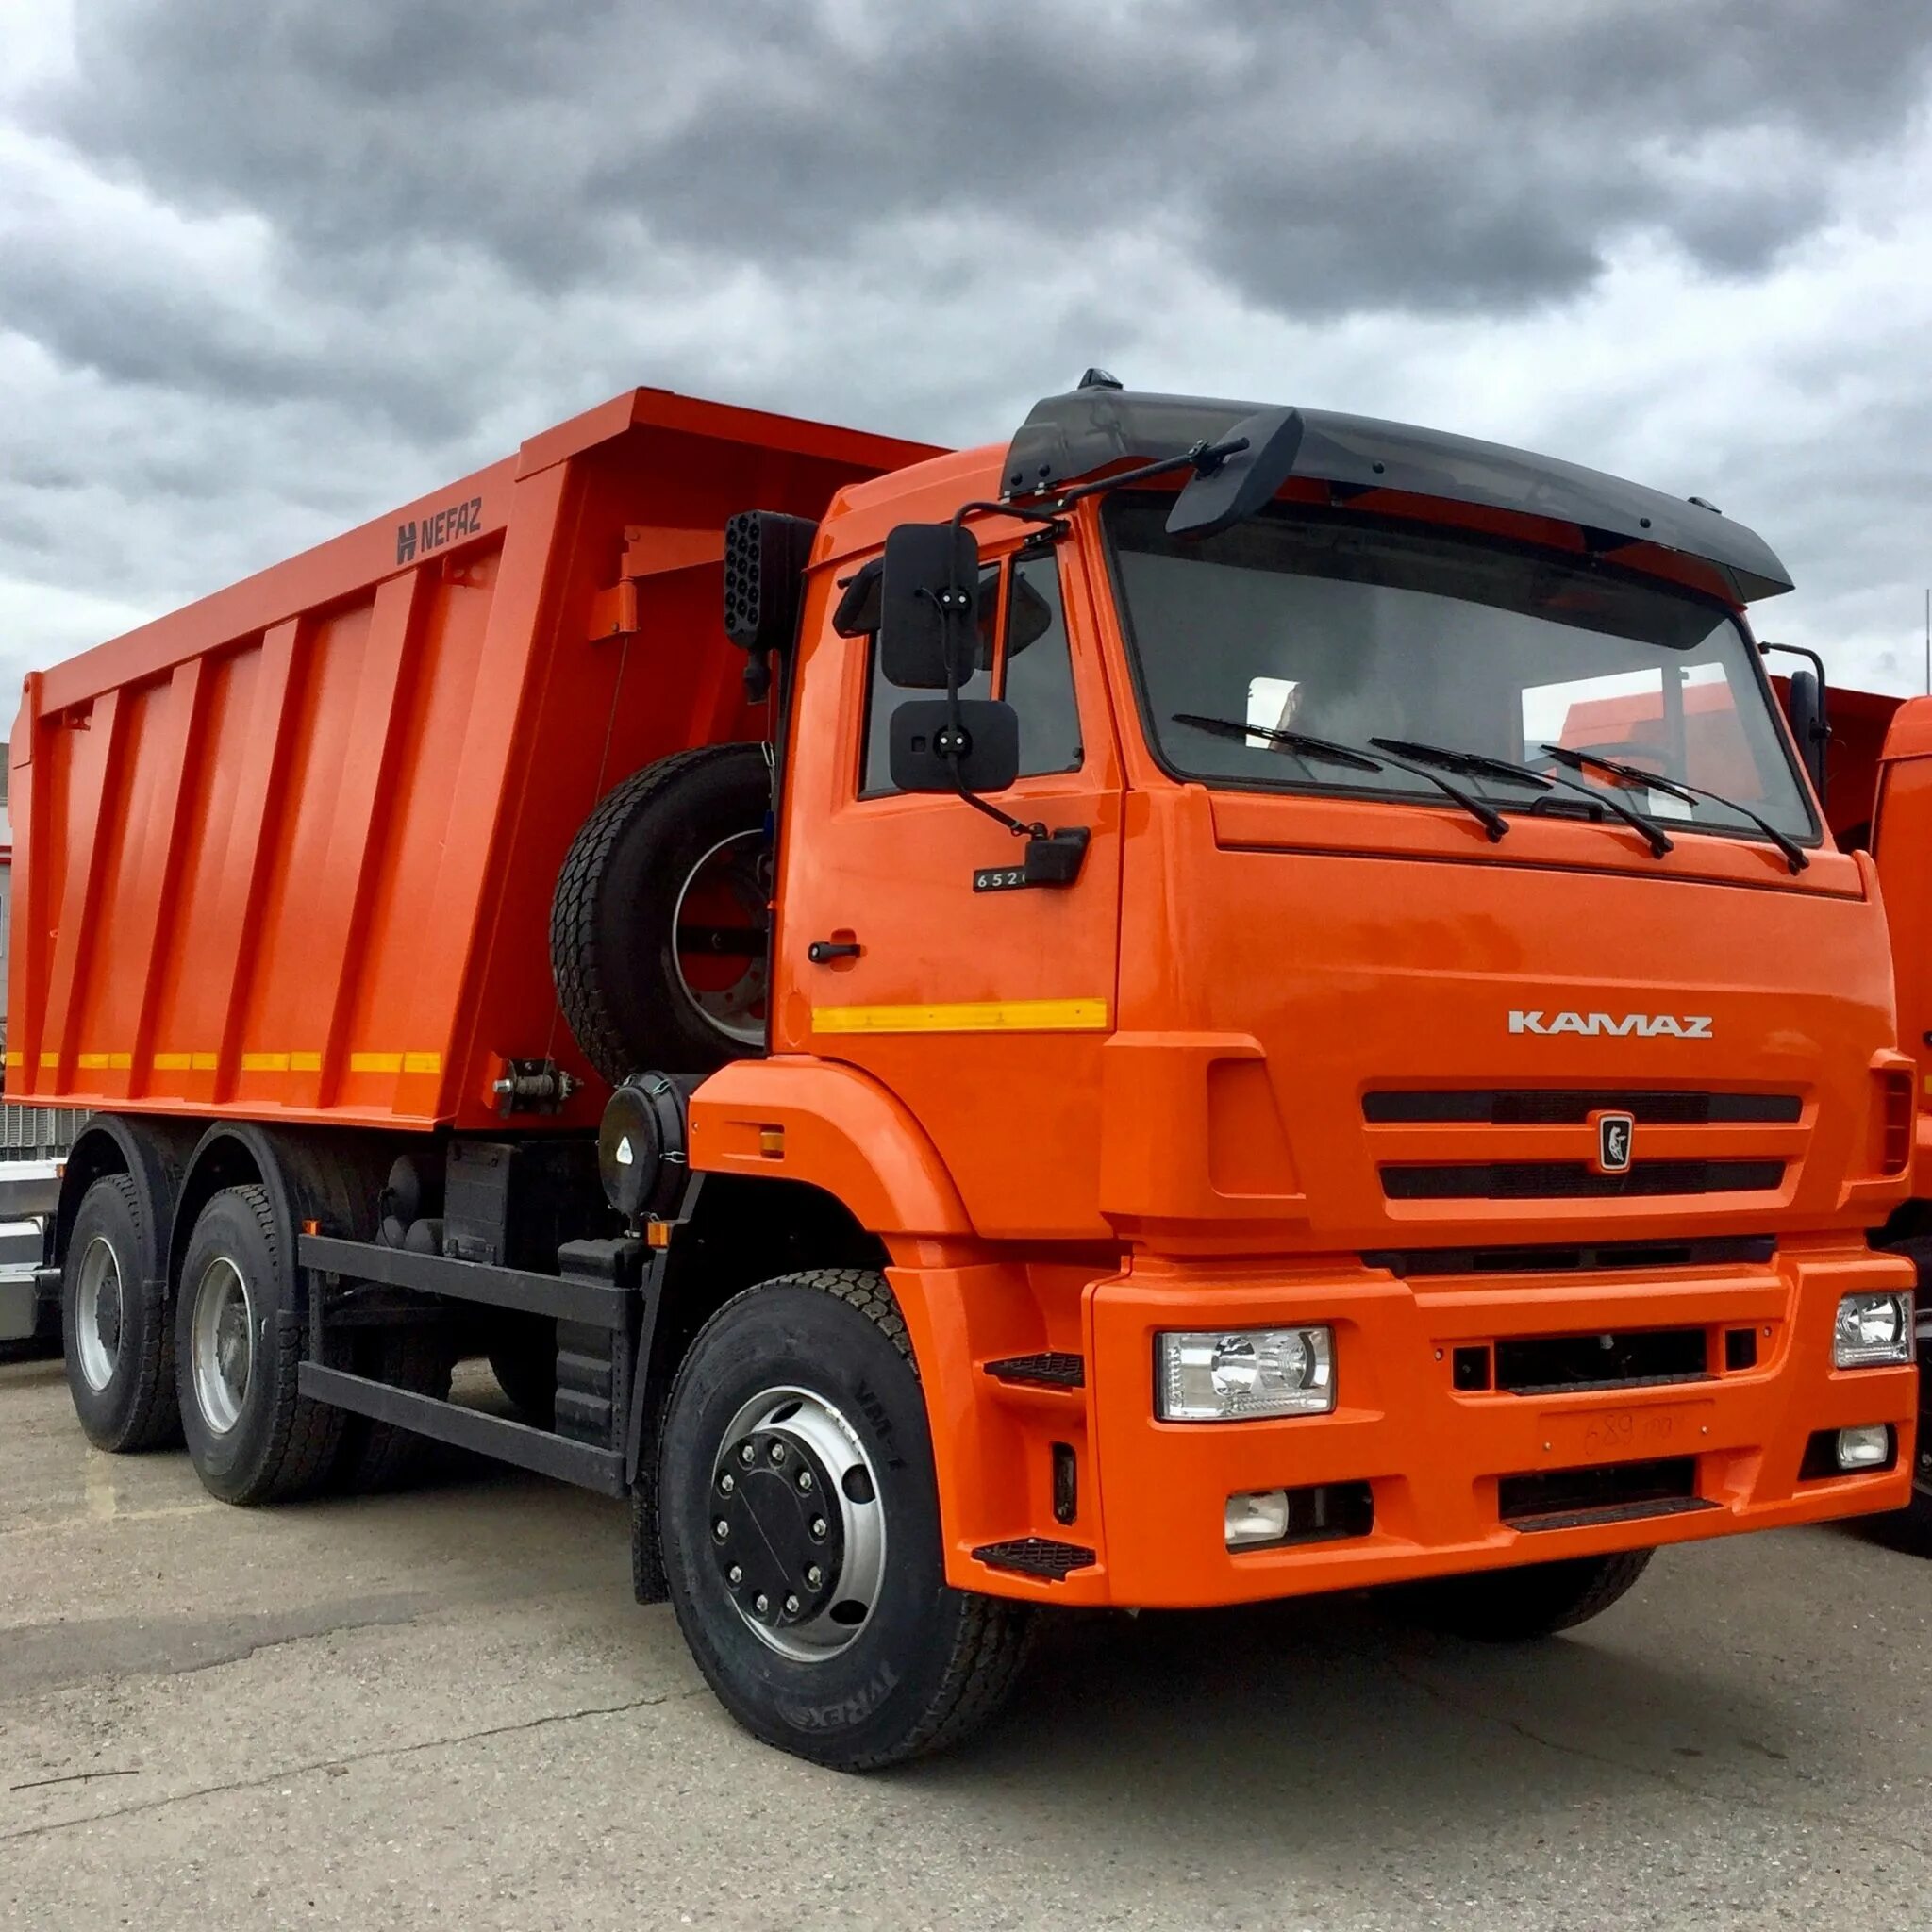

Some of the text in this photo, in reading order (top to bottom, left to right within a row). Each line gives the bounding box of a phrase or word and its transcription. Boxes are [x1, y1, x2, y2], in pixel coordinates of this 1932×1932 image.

[421, 496, 482, 553] NEFAZ
[977, 872, 1026, 888] 652
[1508, 1010, 1713, 1038] KAMAZ
